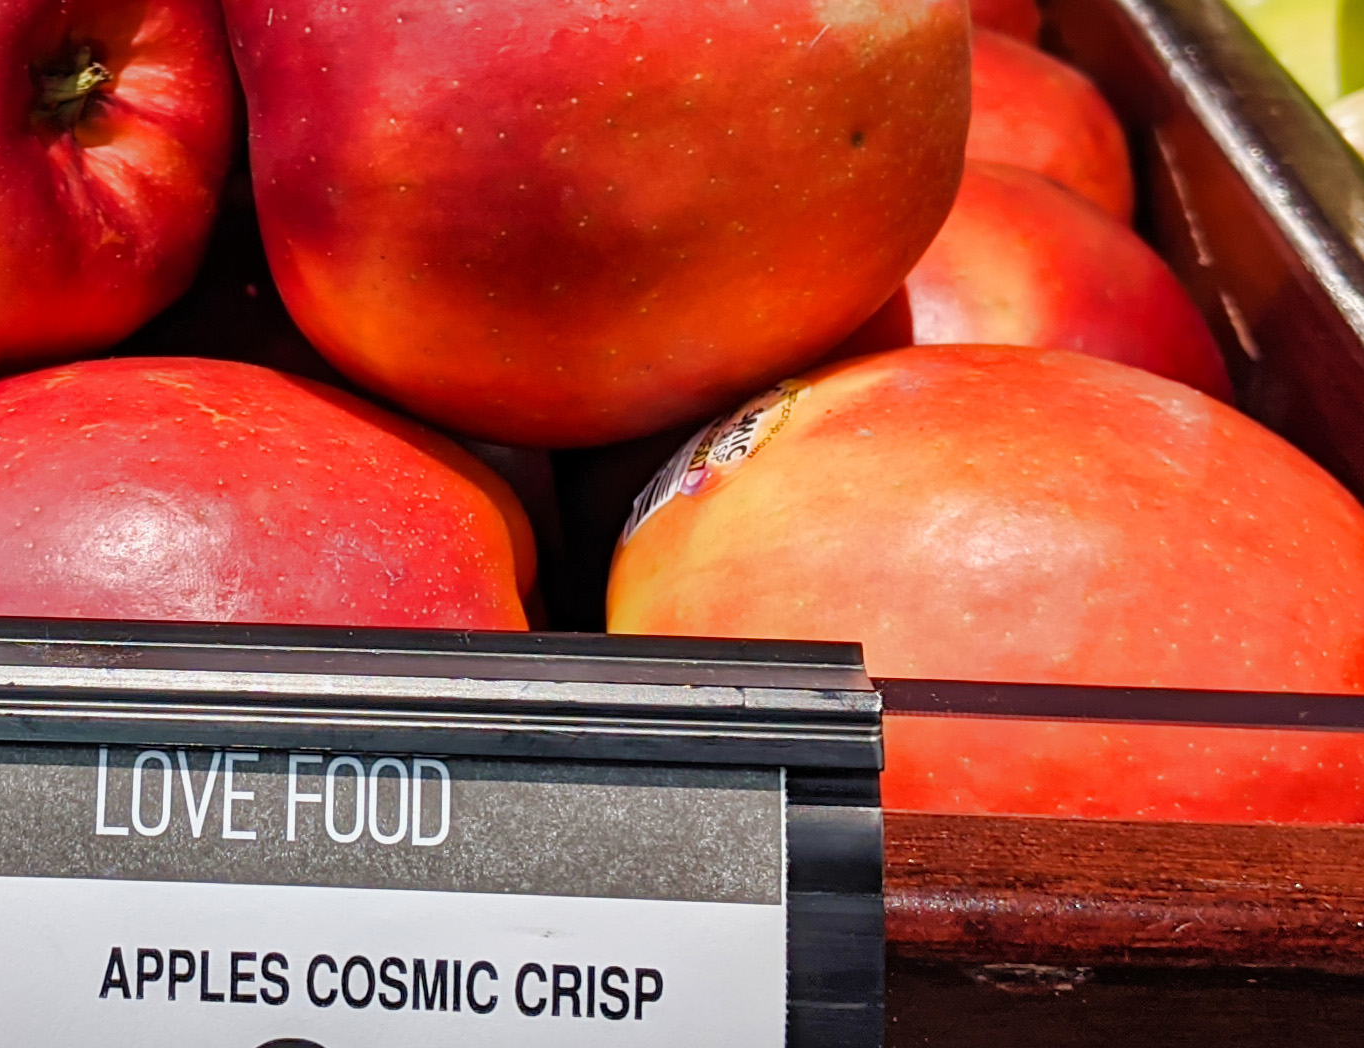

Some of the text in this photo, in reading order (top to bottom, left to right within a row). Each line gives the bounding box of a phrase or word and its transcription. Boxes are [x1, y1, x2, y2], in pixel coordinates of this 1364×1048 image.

[95, 747, 451, 846] LOVE FOOD
[99, 947, 663, 1020] APPLES COSMIC CRISP
